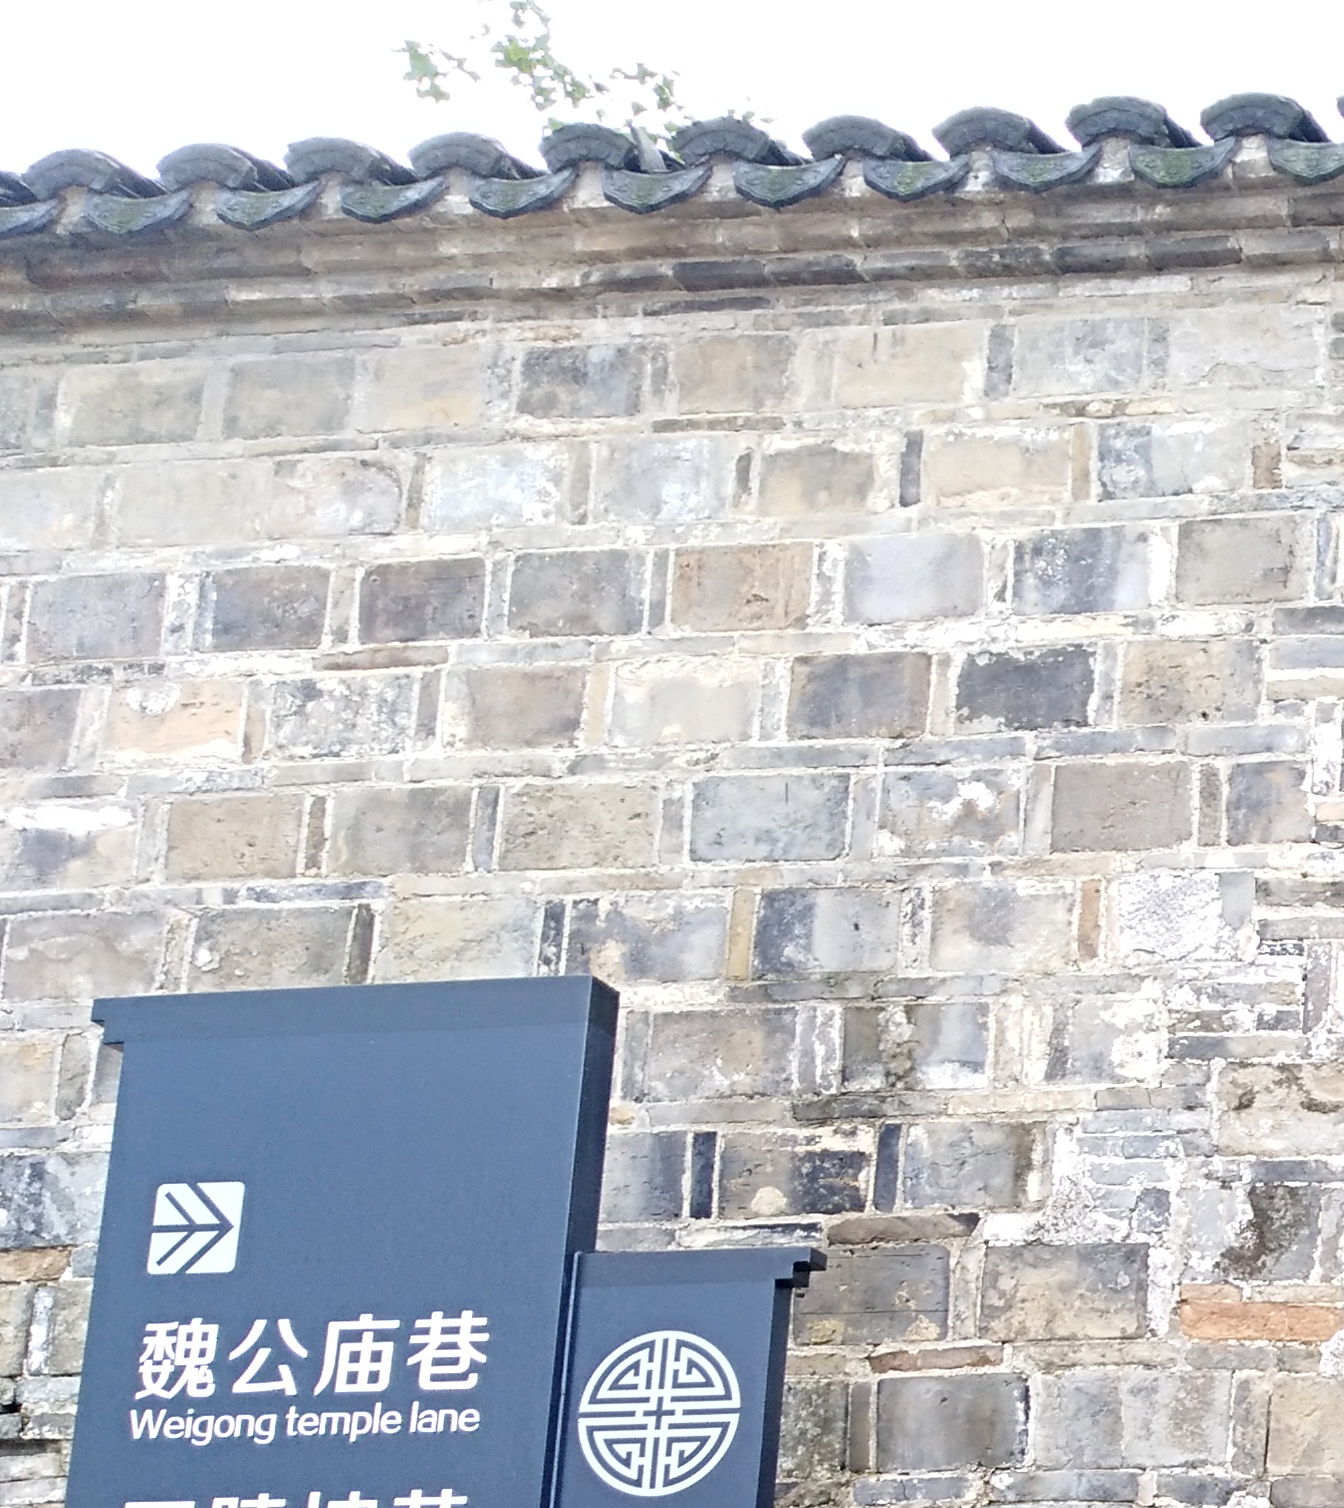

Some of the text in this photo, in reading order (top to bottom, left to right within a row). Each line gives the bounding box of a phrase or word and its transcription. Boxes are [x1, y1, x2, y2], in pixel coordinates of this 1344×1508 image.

[134, 1309, 490, 1402] 魏公庙巷
[129, 1400, 481, 1446] Weigong temple lane
